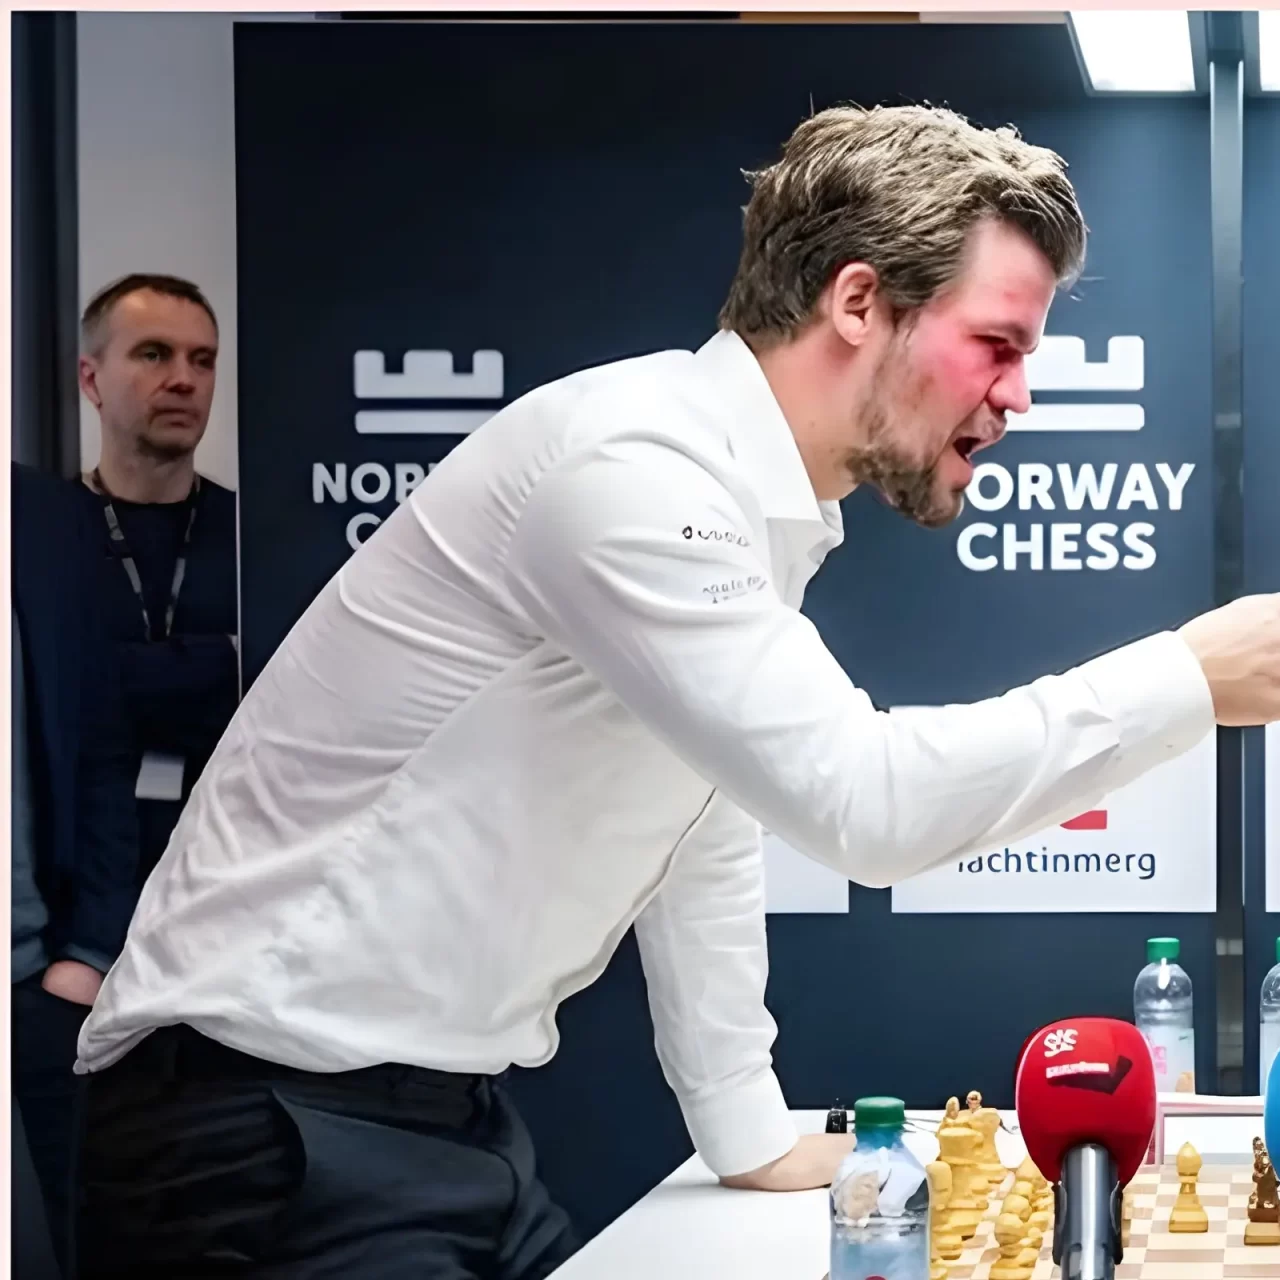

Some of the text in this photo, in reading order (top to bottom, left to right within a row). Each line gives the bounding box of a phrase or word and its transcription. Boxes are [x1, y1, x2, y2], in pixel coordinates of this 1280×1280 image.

[312, 462, 438, 504] NOR
[964, 462, 1196, 512] ORWAY
[956, 522, 1157, 572] CHESS
